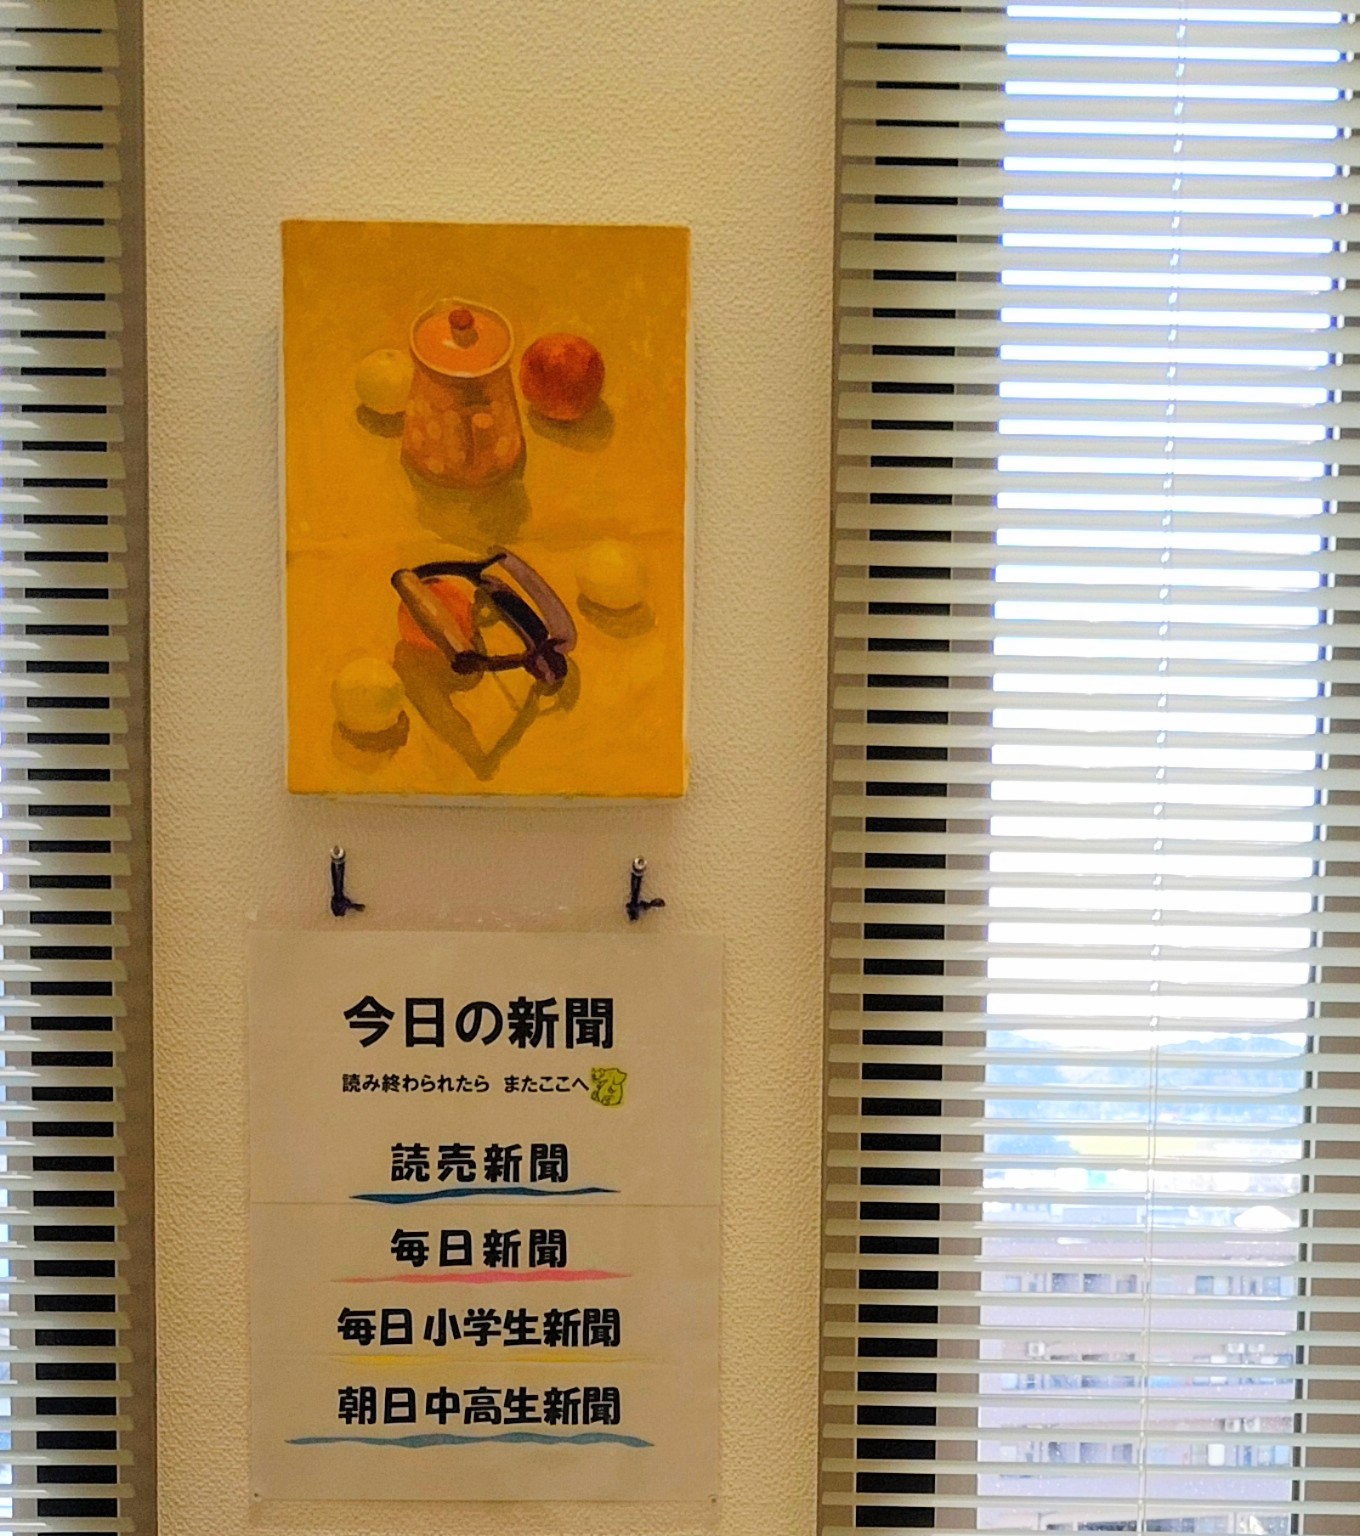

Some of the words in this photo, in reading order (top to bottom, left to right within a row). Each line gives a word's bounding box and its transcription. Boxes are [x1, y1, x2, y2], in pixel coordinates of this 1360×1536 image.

[343, 995, 614, 1048] 今日の新聞
[342, 1073, 490, 1094] 読み終わられたら
[504, 1073, 589, 1094] またここへ
[391, 1143, 569, 1183] 読売新聞
[391, 1229, 568, 1268] 毎日新聞
[337, 1307, 621, 1348] 毎日小学生新聞
[338, 1386, 621, 1426] 朝日中高生新聞
